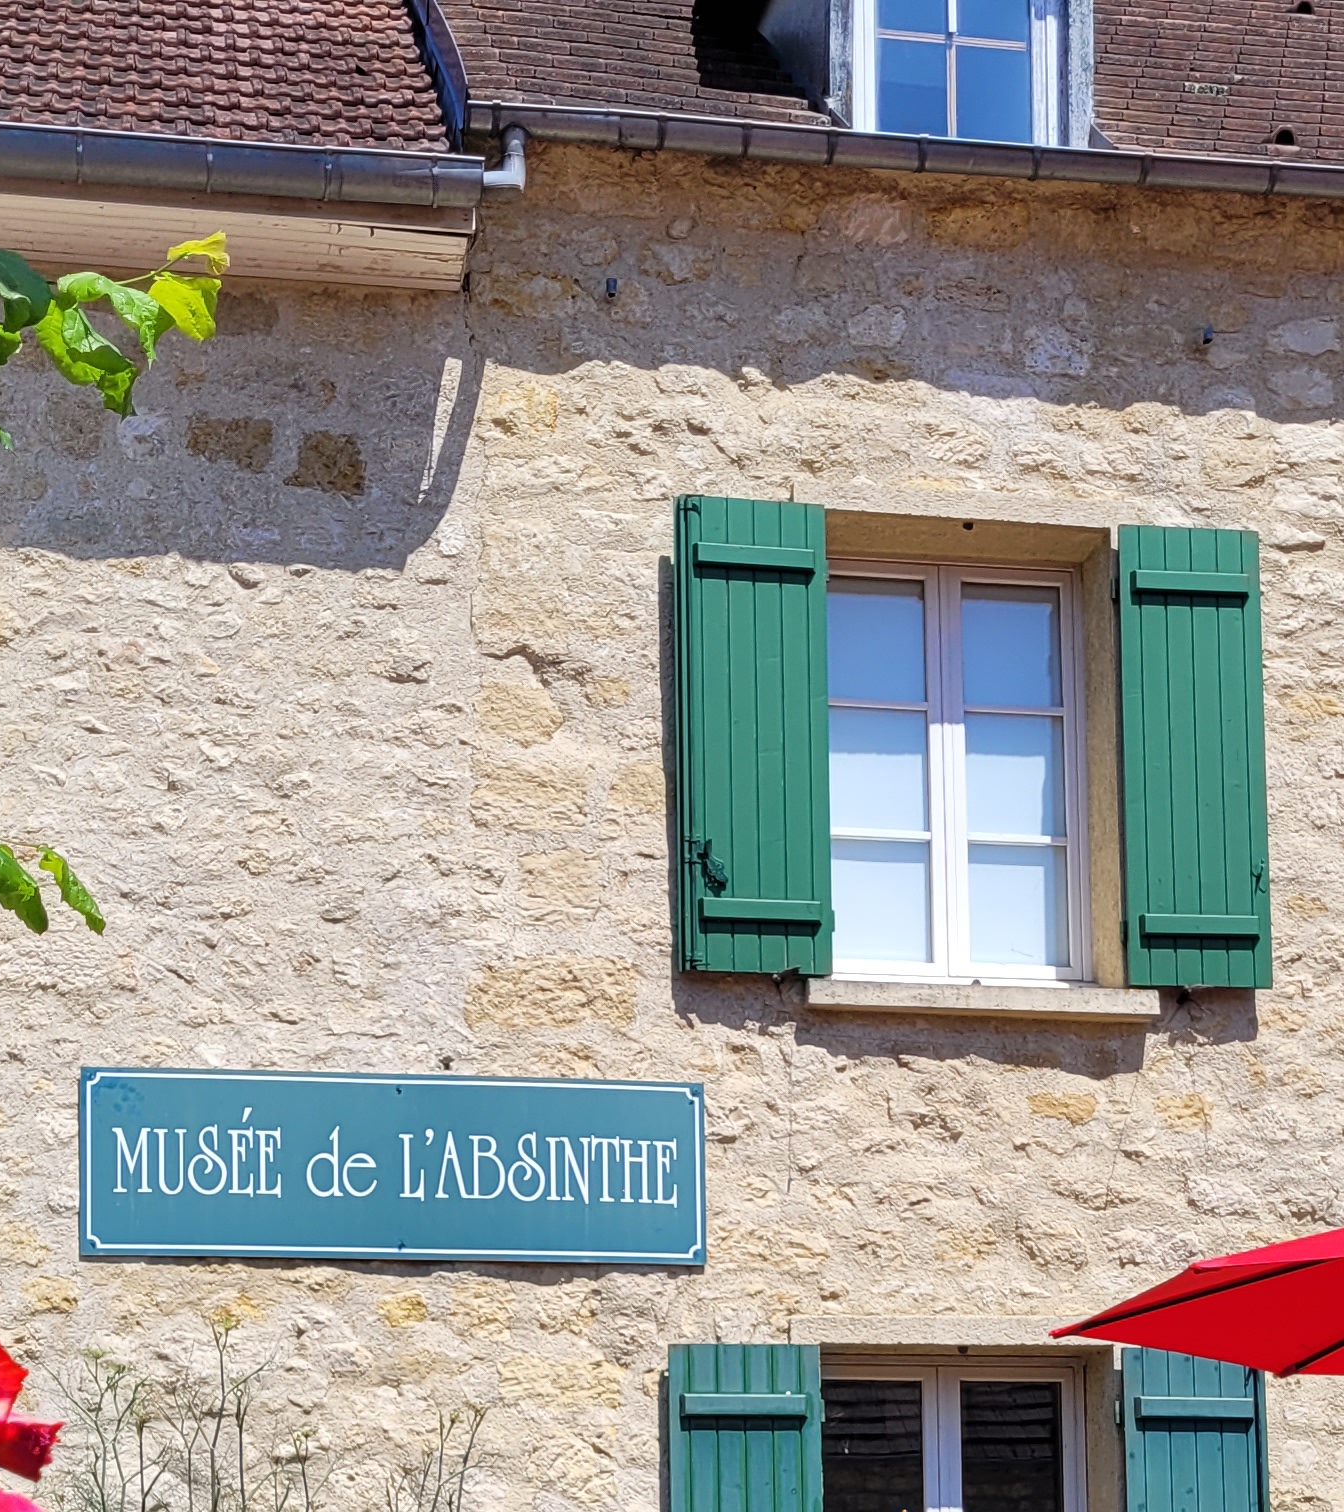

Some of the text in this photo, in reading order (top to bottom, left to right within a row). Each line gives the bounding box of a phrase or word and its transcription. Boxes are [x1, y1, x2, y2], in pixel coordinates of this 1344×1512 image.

[112, 1107, 678, 1208] MUSÉE de L'ABSINTHE
